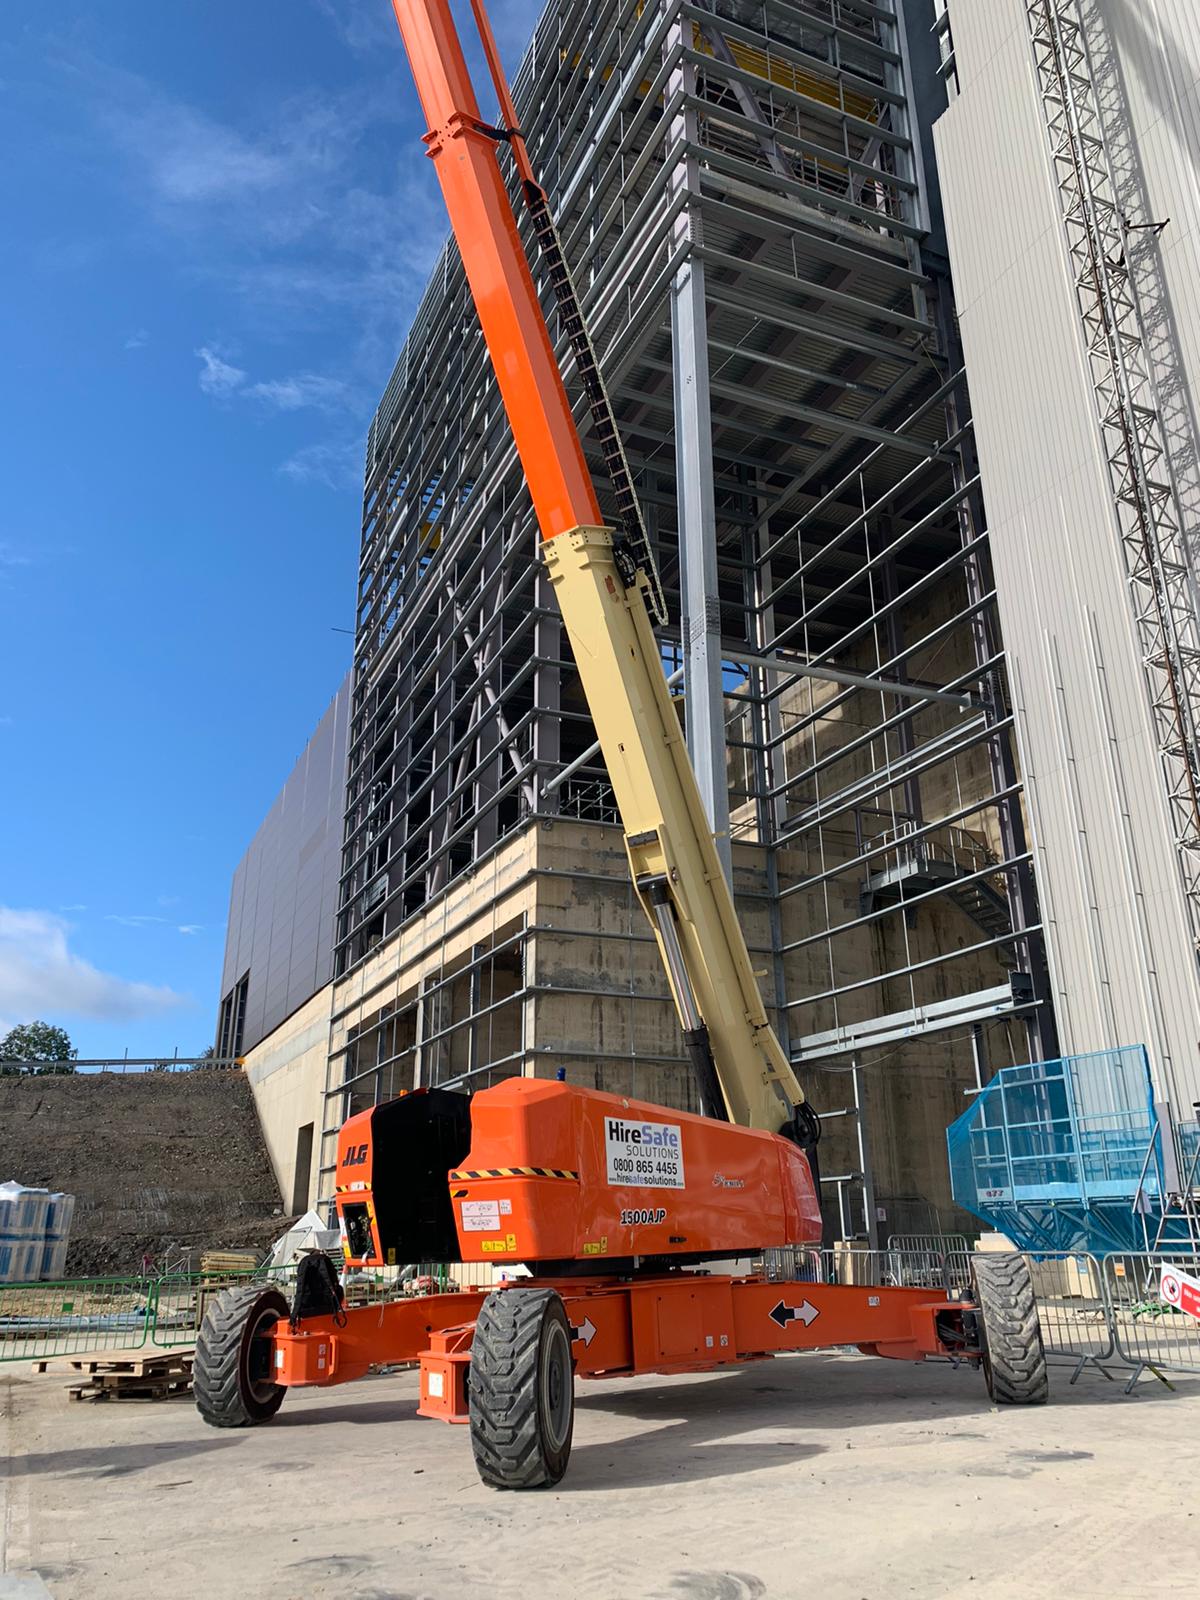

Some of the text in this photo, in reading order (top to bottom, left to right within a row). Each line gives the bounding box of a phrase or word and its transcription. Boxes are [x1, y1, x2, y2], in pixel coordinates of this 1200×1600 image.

[608, 1120, 678, 1147] HireSafe
[342, 1143, 369, 1167] JLG
[626, 1145, 679, 1160] SOLUTIONS
[613, 1157, 678, 1176] 0800 865 4455
[621, 1209, 666, 1224] 1500AJP
